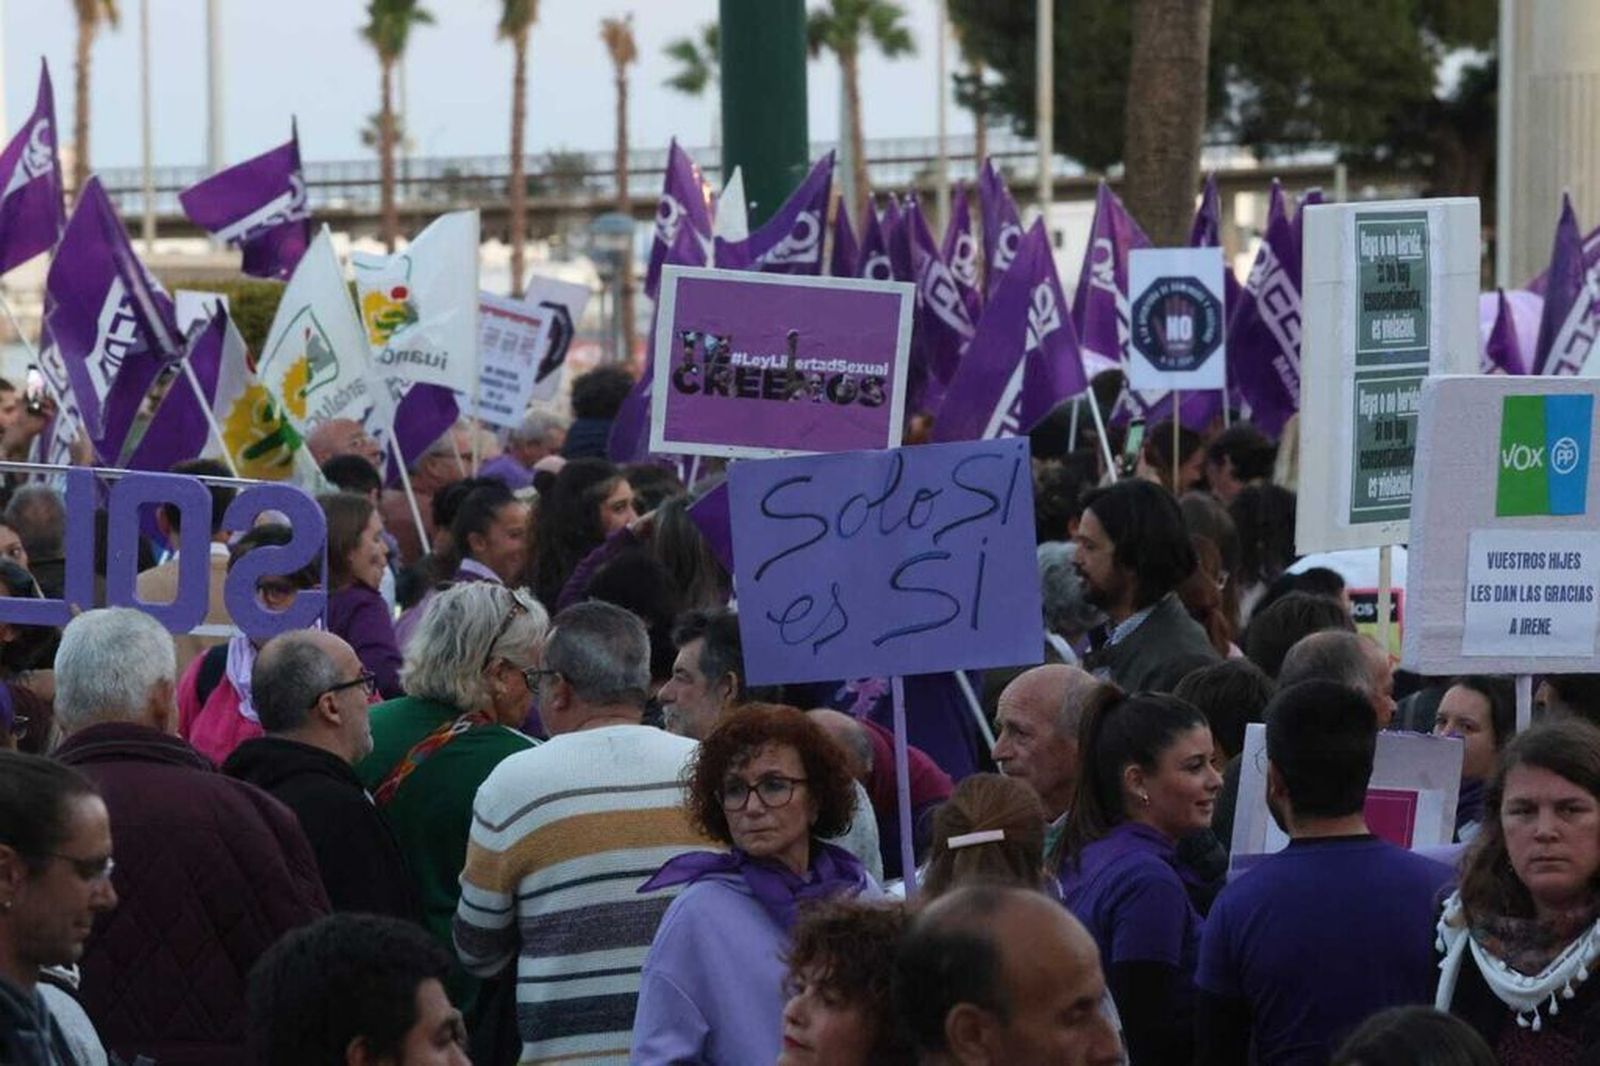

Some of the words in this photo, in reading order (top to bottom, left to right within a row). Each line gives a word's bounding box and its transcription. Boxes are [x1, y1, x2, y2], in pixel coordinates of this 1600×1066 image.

[1166, 315, 1192, 341] NO
[1501, 441, 1544, 471] VOX
[1556, 450, 1574, 466] PP
[1487, 552, 1546, 570] VUESTROS
[1548, 552, 1582, 570] HIJES
[1471, 585, 1492, 602] LES
[1494, 585, 1518, 602] DAN
[1519, 585, 1542, 602] LAS
[1544, 585, 1594, 602] GRACIAS
[766, 581, 848, 655] es
[1508, 617, 1518, 635] A
[1520, 617, 1552, 635] IRENE
